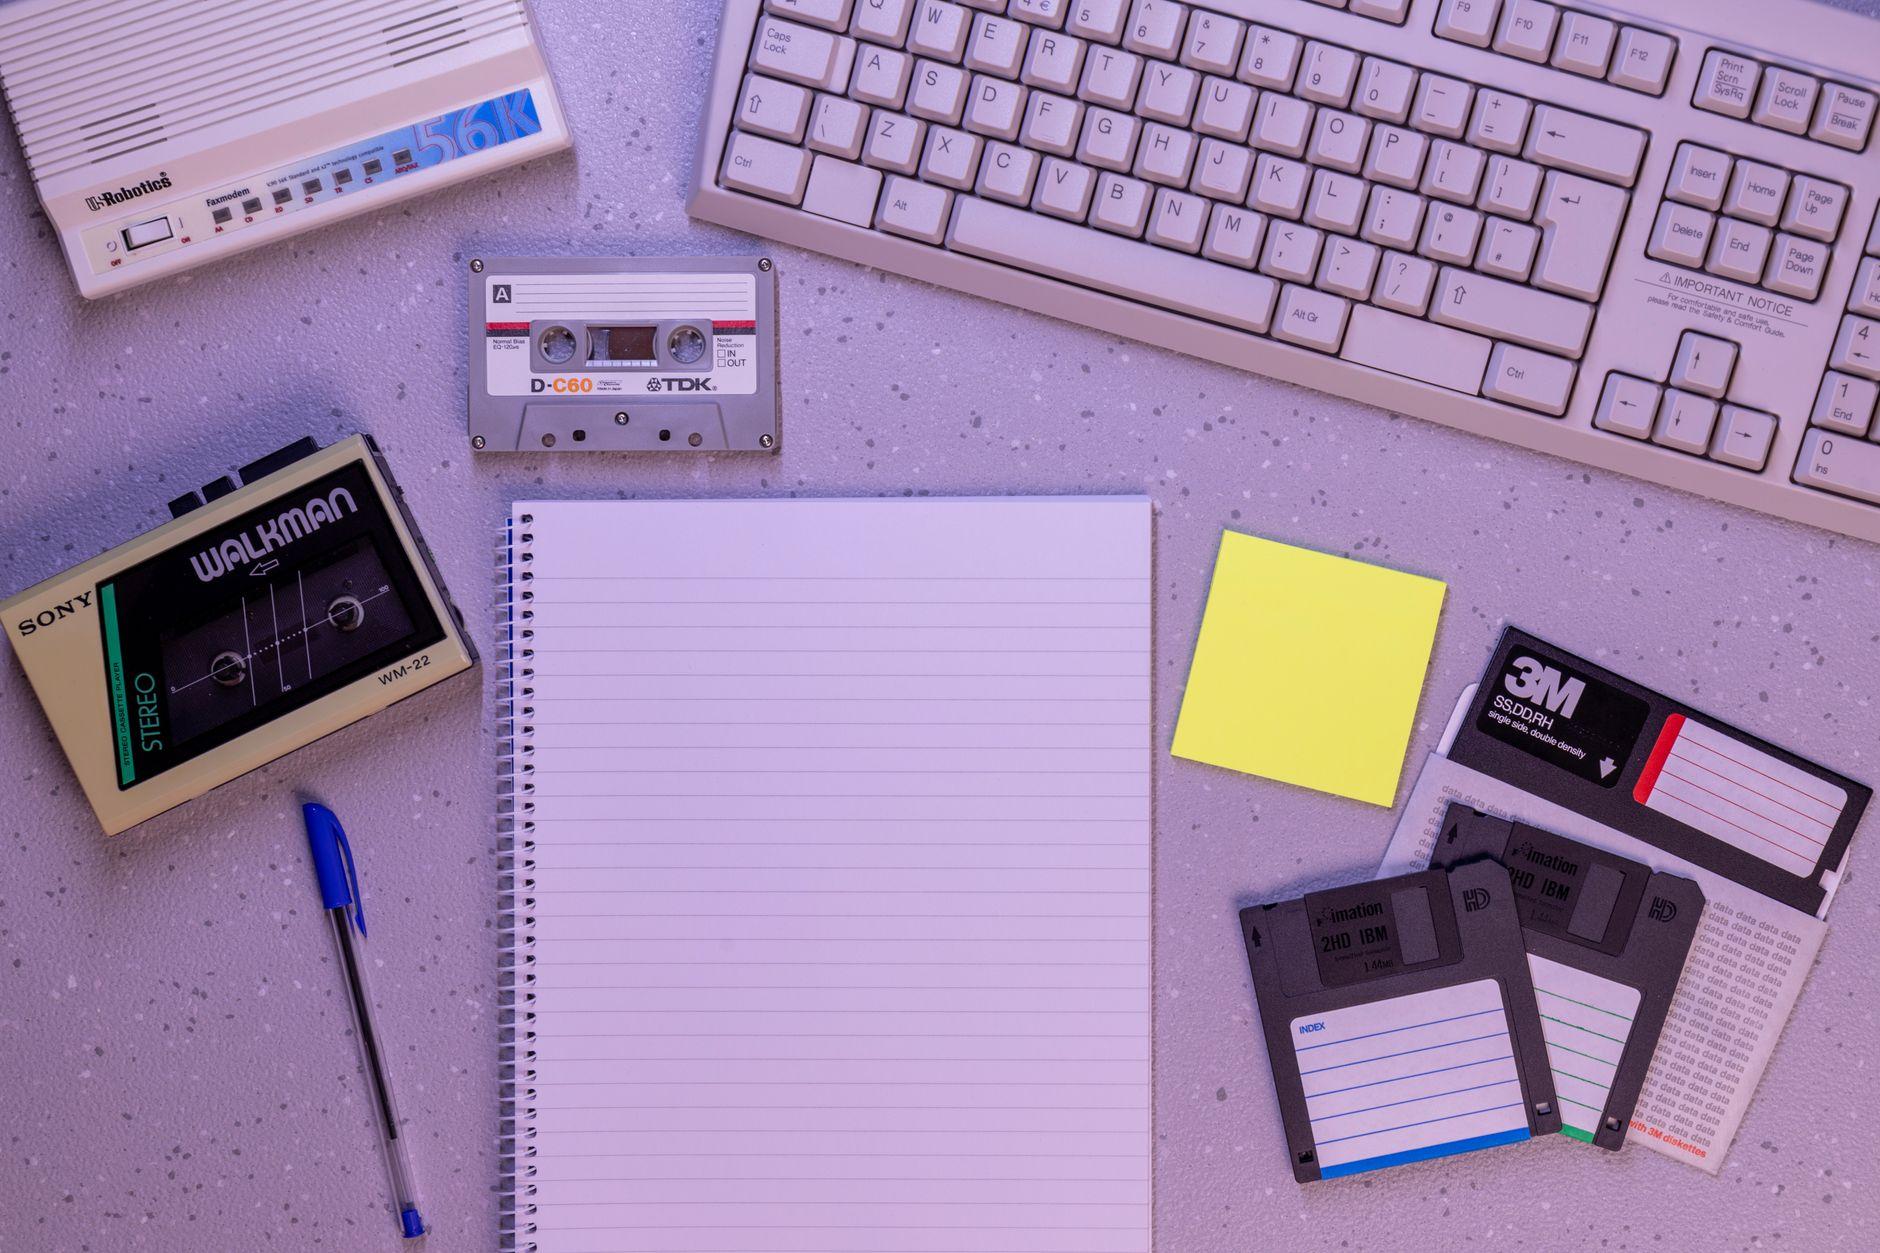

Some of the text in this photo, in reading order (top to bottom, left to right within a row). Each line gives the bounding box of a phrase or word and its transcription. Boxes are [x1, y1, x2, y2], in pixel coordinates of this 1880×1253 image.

[1456, 0, 1470, 12] F9
[927, 7, 942, 24] W
[1080, 9, 1090, 22] 5
[1515, 17, 1534, 30] F10
[767, 28, 792, 43] Caps
[984, 22, 997, 40] E
[1137, 26, 1147, 38] 6
[1572, 32, 1589, 46] F11
[764, 40, 788, 54] Lock
[1042, 38, 1056, 56] R
[1196, 41, 1206, 54] 7
[1630, 48, 1648, 62] F12
[867, 54, 880, 71] A
[1102, 54, 1114, 71] T
[1254, 58, 1264, 70] 8
[1720, 58, 1744, 73] Print
[925, 70, 938, 86] S
[1160, 70, 1172, 86] Y
[1312, 74, 1321, 86] 9
[1717, 70, 1738, 84] Scrn
[982, 86, 997, 102] D
[1215, 86, 1228, 102] U
[1714, 84, 1744, 102] SysRq
[1778, 82, 1807, 98] Scroll
[1774, 94, 1800, 110] Lock
[1838, 92, 1866, 108] Pause
[1039, 101, 1053, 117] F
[412, 88, 543, 165] 56K
[880, 120, 895, 138] Z
[1098, 117, 1112, 134] G
[1830, 115, 1858, 130] Break
[938, 136, 953, 154] X
[1154, 134, 1170, 152] H
[1386, 133, 1400, 148] P
[289, 169, 310, 180] Standard
[311, 166, 320, 174] and
[332, 154, 358, 167] technology
[358, 146, 384, 158] compatible
[734, 155, 752, 169] Ctrl
[996, 152, 1011, 168] C
[1213, 150, 1225, 165] J
[1056, 168, 1068, 184] V
[1270, 165, 1284, 182] K
[1690, 166, 1716, 181] Insert
[206, 187, 250, 207] Faxmodem
[1110, 184, 1124, 200] B
[1327, 180, 1338, 198] L
[1748, 182, 1776, 198] Home
[894, 199, 908, 212] Alt
[1808, 190, 1834, 206] Page
[1167, 199, 1183, 217] N
[1804, 202, 1818, 215] Up
[1225, 214, 1242, 233] M
[1672, 222, 1703, 240] Delete
[1730, 238, 1750, 252] End
[111, 258, 122, 267] OFF
[1789, 248, 1814, 263] Page
[1786, 260, 1814, 276] Down
[495, 288, 510, 302] A
[1674, 276, 1794, 317] IMPORTANT NOTICE
[1647, 296, 1670, 307] please
[1671, 302, 1687, 312] read
[1688, 306, 1700, 315] the
[1702, 310, 1724, 323] Safety
[1734, 318, 1762, 332] Comfort
[1668, 292, 1678, 301] For
[1680, 297, 1722, 313] comfortable
[1723, 307, 1736, 317] and
[1738, 312, 1754, 322] safe
[1858, 325, 1870, 340] 4
[727, 359, 746, 367] OUT
[1506, 366, 1525, 380] Ctrl
[531, 378, 593, 393] D-C60
[1833, 408, 1854, 422] End
[1815, 462, 1828, 476] Ins
[190, 487, 358, 582] WALKMAN
[378, 584, 390, 594] 100
[17, 591, 92, 637] SONY
[378, 654, 431, 686] WM-22
[283, 684, 292, 692] 50
[1504, 656, 1586, 720] 3M
[113, 662, 131, 767] STEREO CASSETTE PLAYER
[134, 672, 162, 752] STEREO
[1494, 695, 1554, 730] SS,DD,RH
[1488, 709, 1587, 760] single side, double density
[1442, 785, 1507, 820] data data data
[1526, 847, 1578, 877] imation
[1540, 878, 1571, 902] IBM
[1330, 902, 1384, 924] imation
[1713, 901, 1801, 945] data data data data
[1321, 925, 1388, 953] 2HD IBM
[1300, 1022, 1326, 1034] INDEX
[1646, 1114, 1711, 1148] data data data
[1647, 1127, 1664, 1142] 3M
[1662, 1134, 1707, 1158] diskettes
